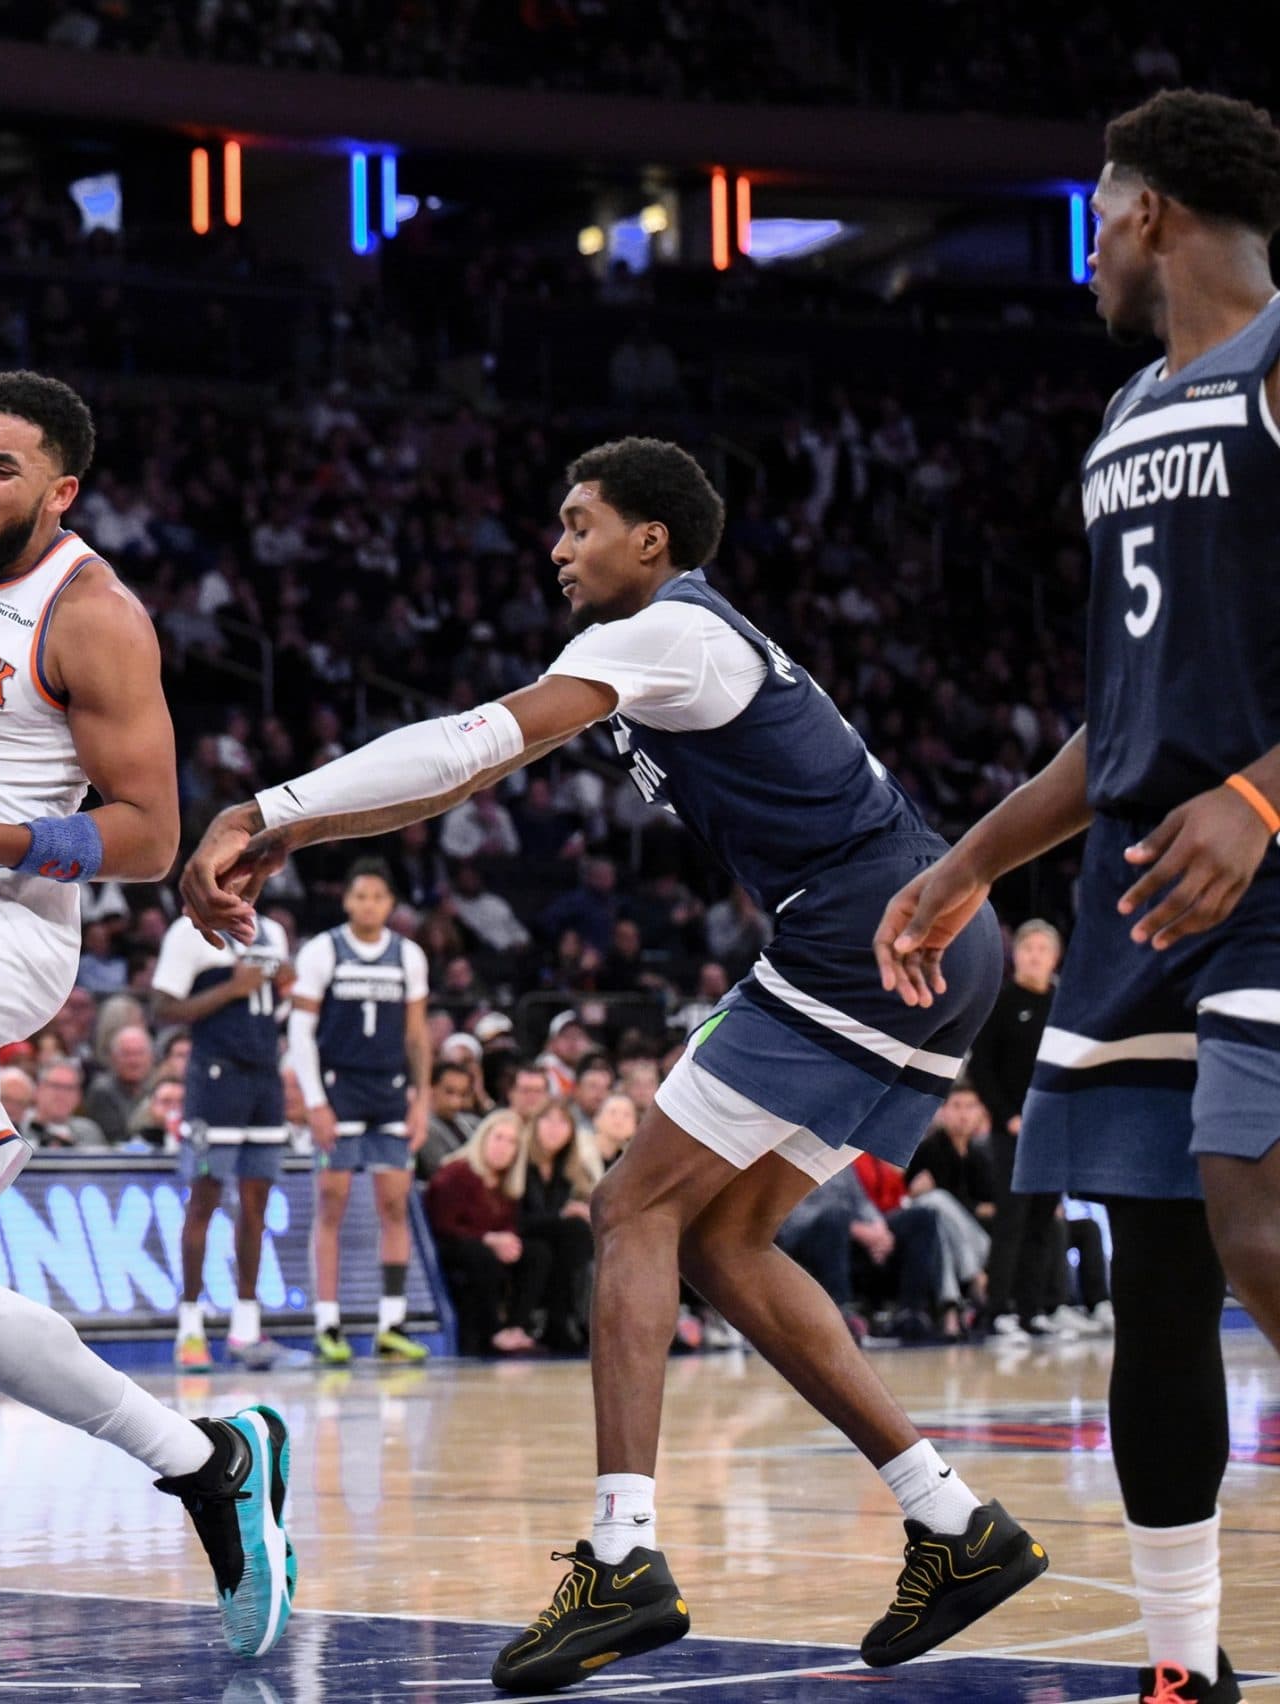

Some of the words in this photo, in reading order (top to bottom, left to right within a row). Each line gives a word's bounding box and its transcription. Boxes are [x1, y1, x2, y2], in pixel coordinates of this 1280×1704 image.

[1082, 441, 1230, 531] MINNESOTA
[1122, 526, 1162, 639] 5
[361, 1000, 378, 1038] 1
